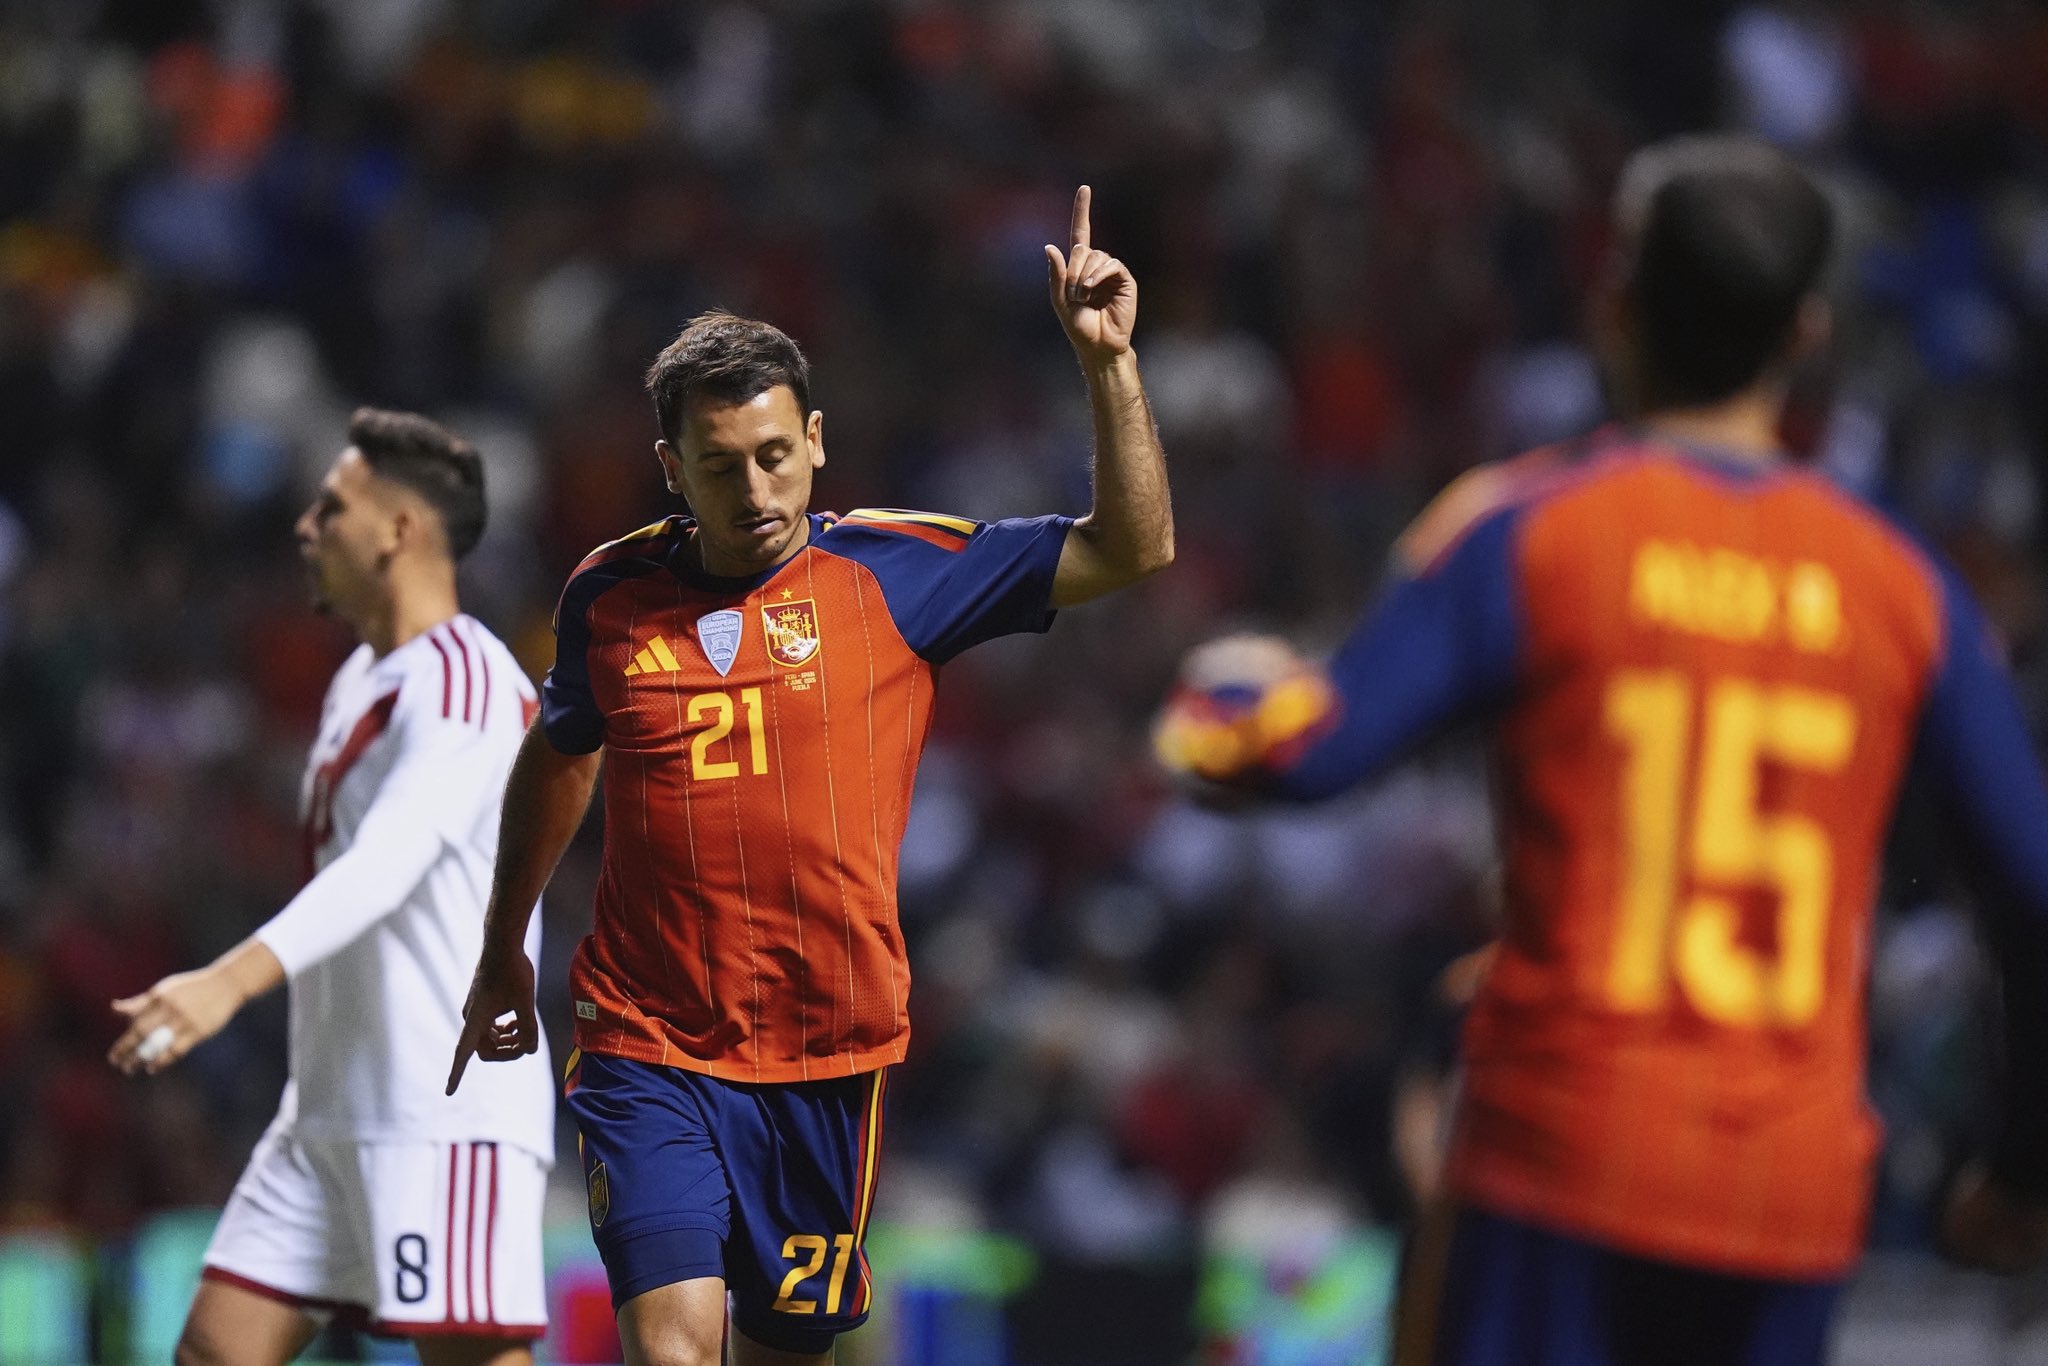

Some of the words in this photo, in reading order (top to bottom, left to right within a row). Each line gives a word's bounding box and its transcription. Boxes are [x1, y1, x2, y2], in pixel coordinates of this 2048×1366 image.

[702, 617, 738, 629] EUROPEAN
[702, 625, 738, 635] CHAMPIONS
[713, 652, 732, 661] 2024
[687, 687, 768, 781] 21
[1605, 668, 1859, 1027] 15
[396, 1233, 429, 1304] 8
[771, 1234, 854, 1314] 21
